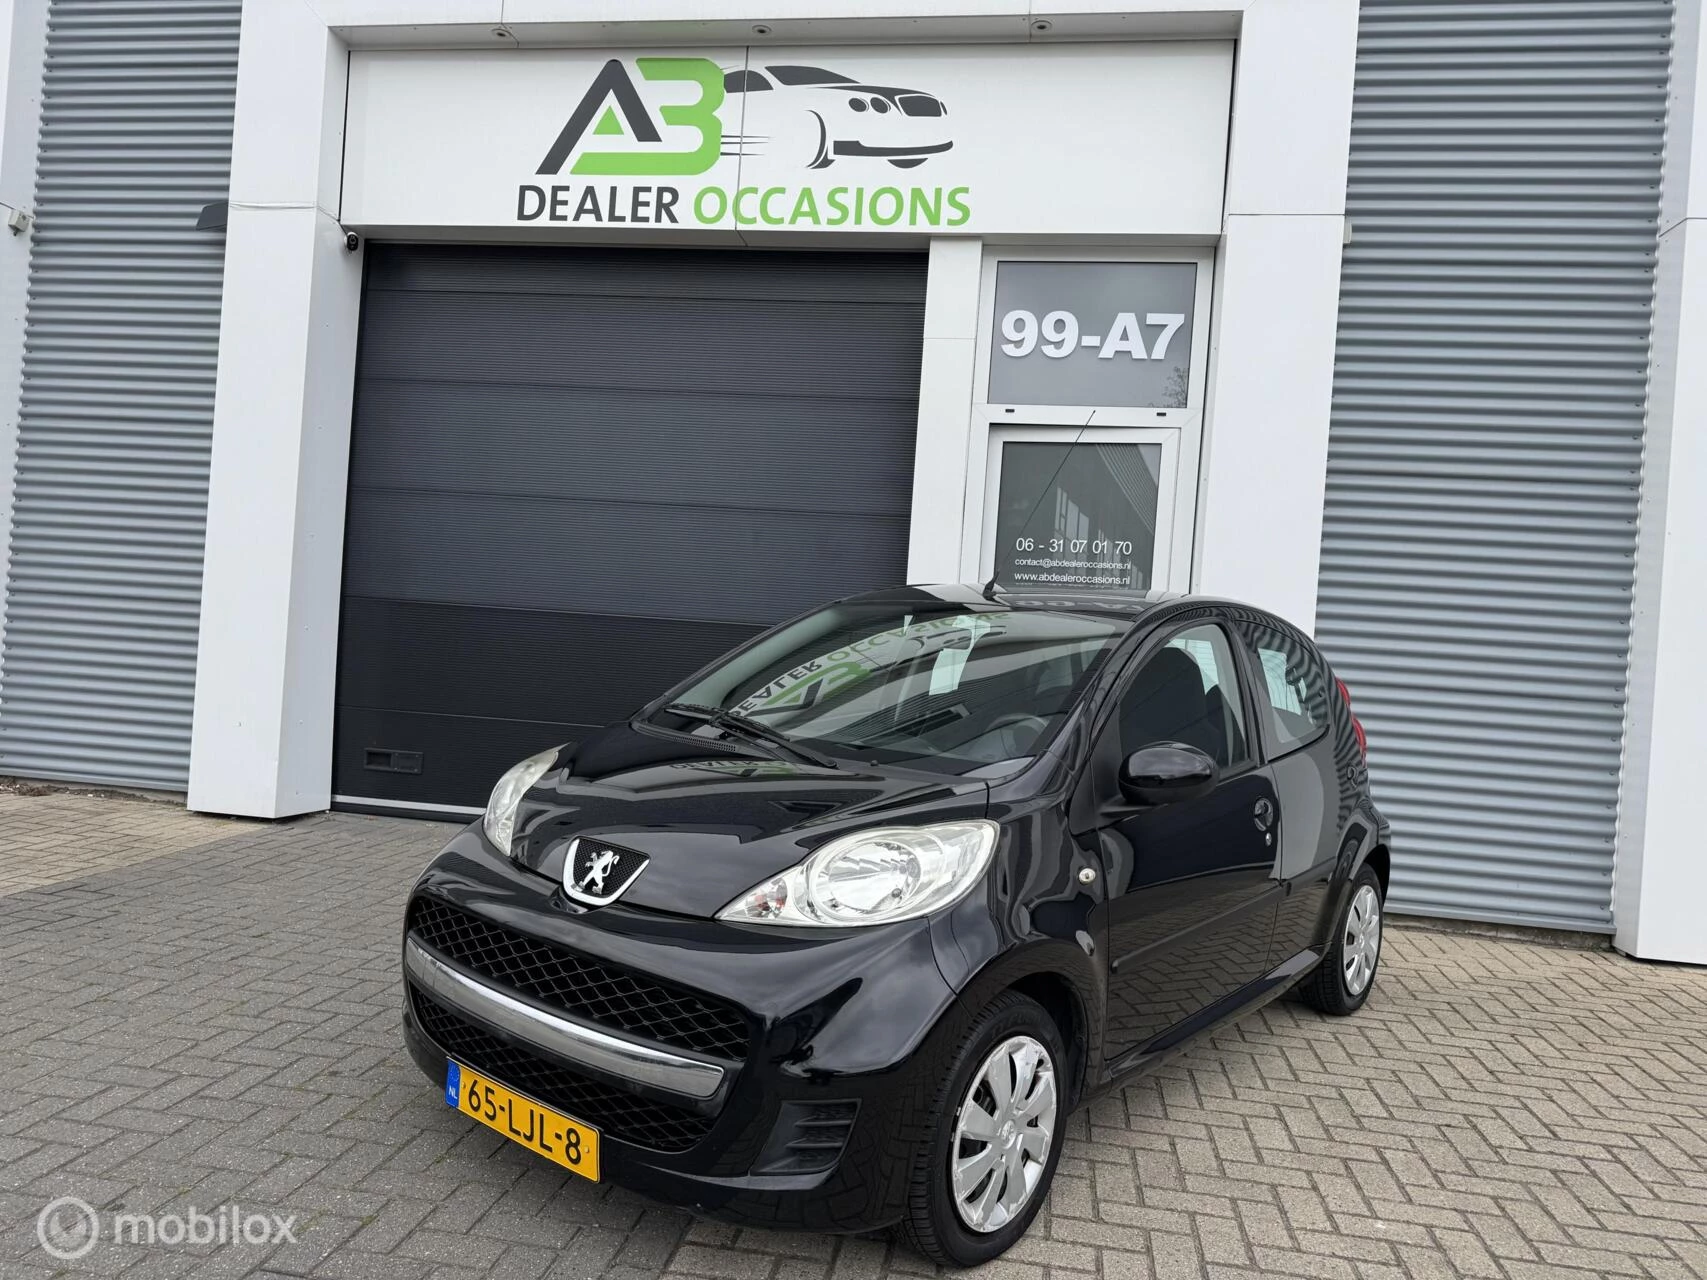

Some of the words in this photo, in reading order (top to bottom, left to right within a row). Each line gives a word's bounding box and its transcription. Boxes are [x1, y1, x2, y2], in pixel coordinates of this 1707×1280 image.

[516, 184, 679, 224] DEALER
[693, 185, 971, 226] OCCASIONS
[1001, 309, 1185, 360] 99-A7
[1016, 537, 1034, 552] 06
[1049, 538, 1064, 553] 31
[1070, 539, 1087, 554] 07
[1092, 540, 1108, 554] 01
[1115, 541, 1132, 555] 70
[1014, 557, 1131, 570] contact@abdealeroccasions.nl
[1014, 572, 1130, 585] www.abdealeroccasions.nl
[448, 1085, 458, 1099] NL
[468, 1079, 581, 1165] 65-LJL-8
